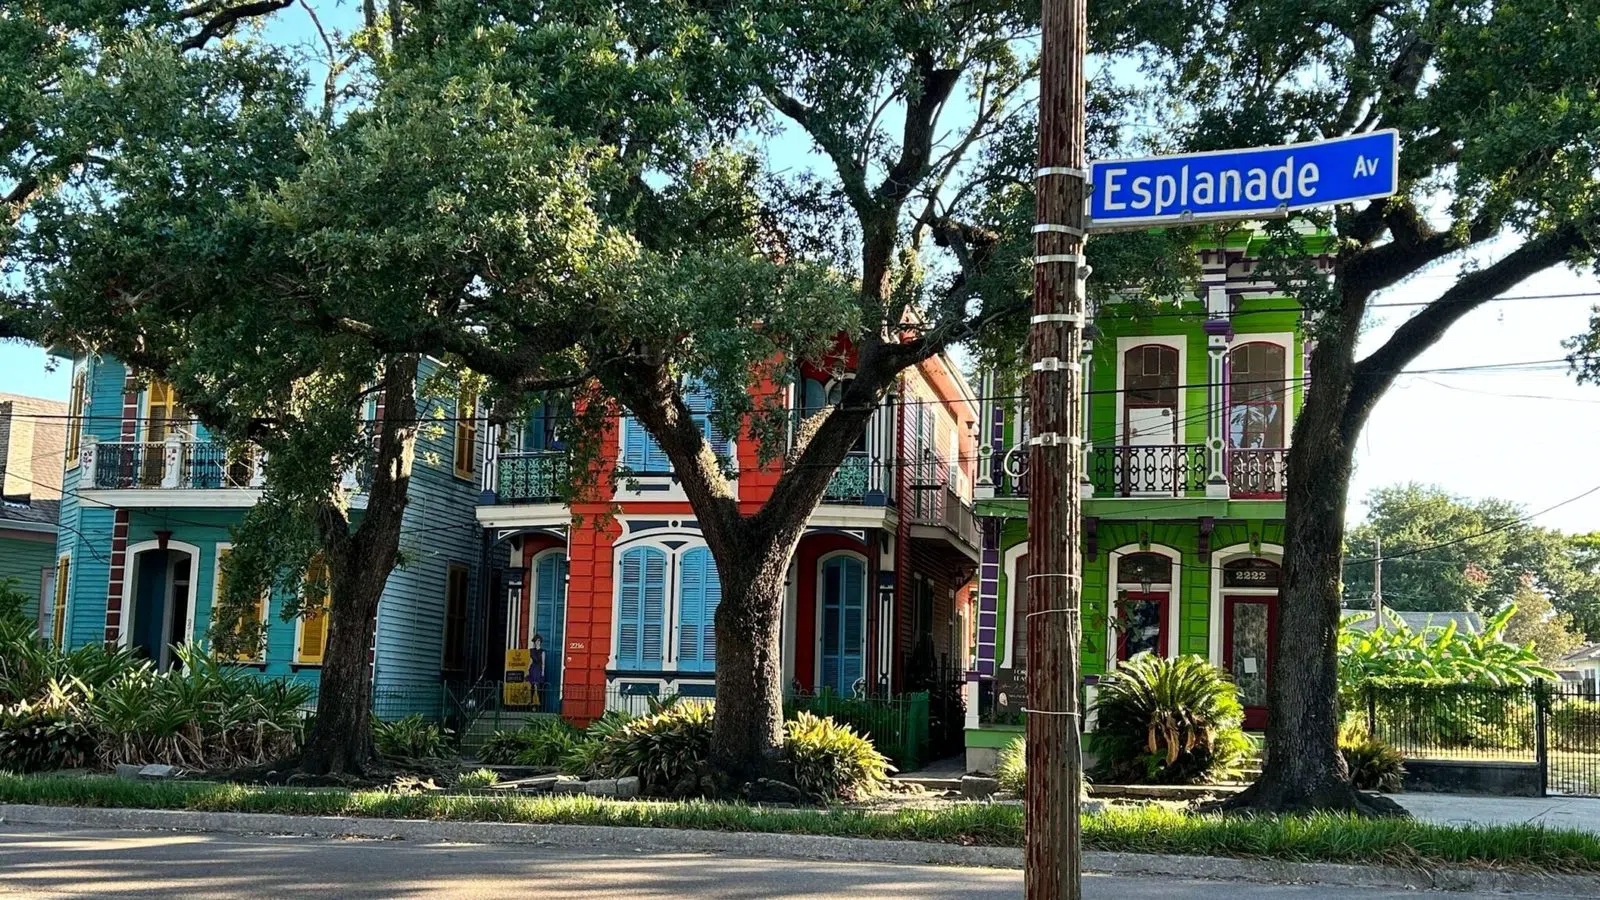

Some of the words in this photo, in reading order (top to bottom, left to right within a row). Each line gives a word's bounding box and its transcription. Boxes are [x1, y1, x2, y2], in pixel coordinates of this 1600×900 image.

[1103, 156, 1320, 215] Esplanade
[1353, 155, 1379, 179] Av
[1236, 571, 1266, 580] 2222
